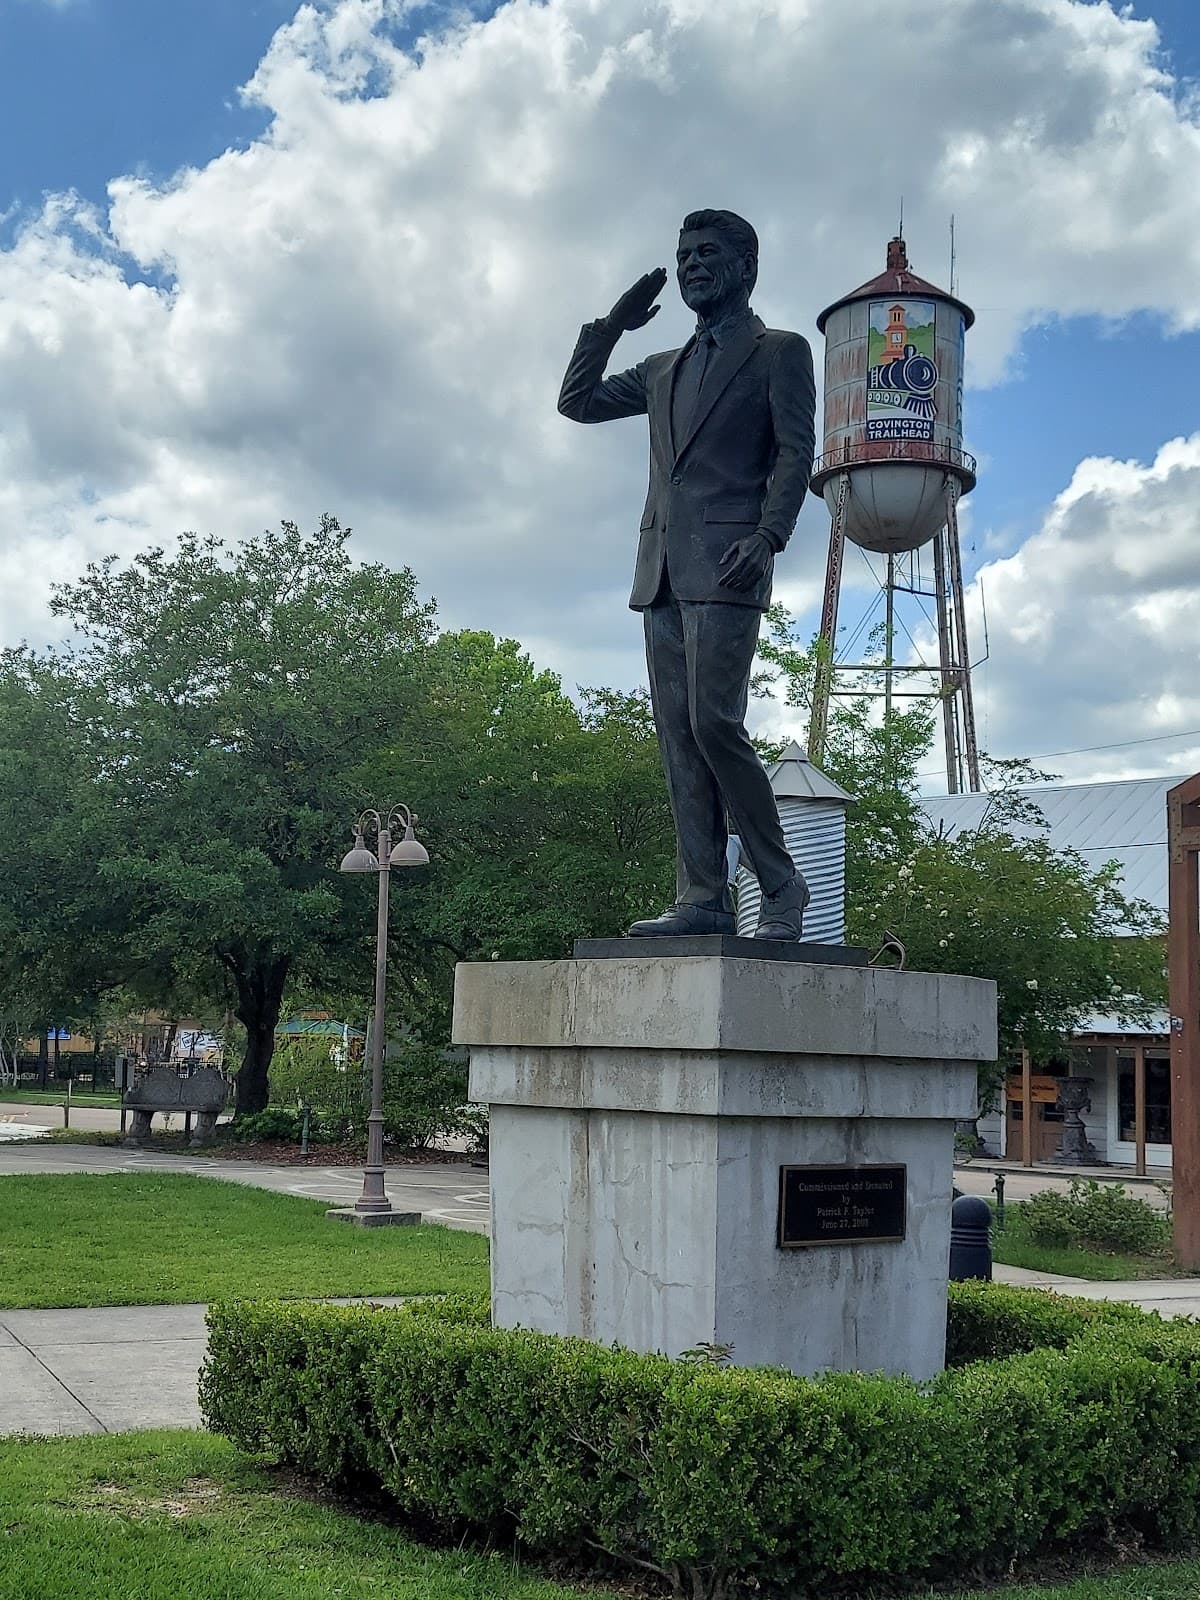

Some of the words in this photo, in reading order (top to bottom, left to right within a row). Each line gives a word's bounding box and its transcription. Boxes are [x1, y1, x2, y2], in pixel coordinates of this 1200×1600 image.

[868, 420, 930, 430] COVINGTON
[868, 429, 930, 439] TRAILHEAD
[841, 1193, 851, 1205] by
[817, 1207, 841, 1216] Patrick
[821, 1219, 838, 1229] June
